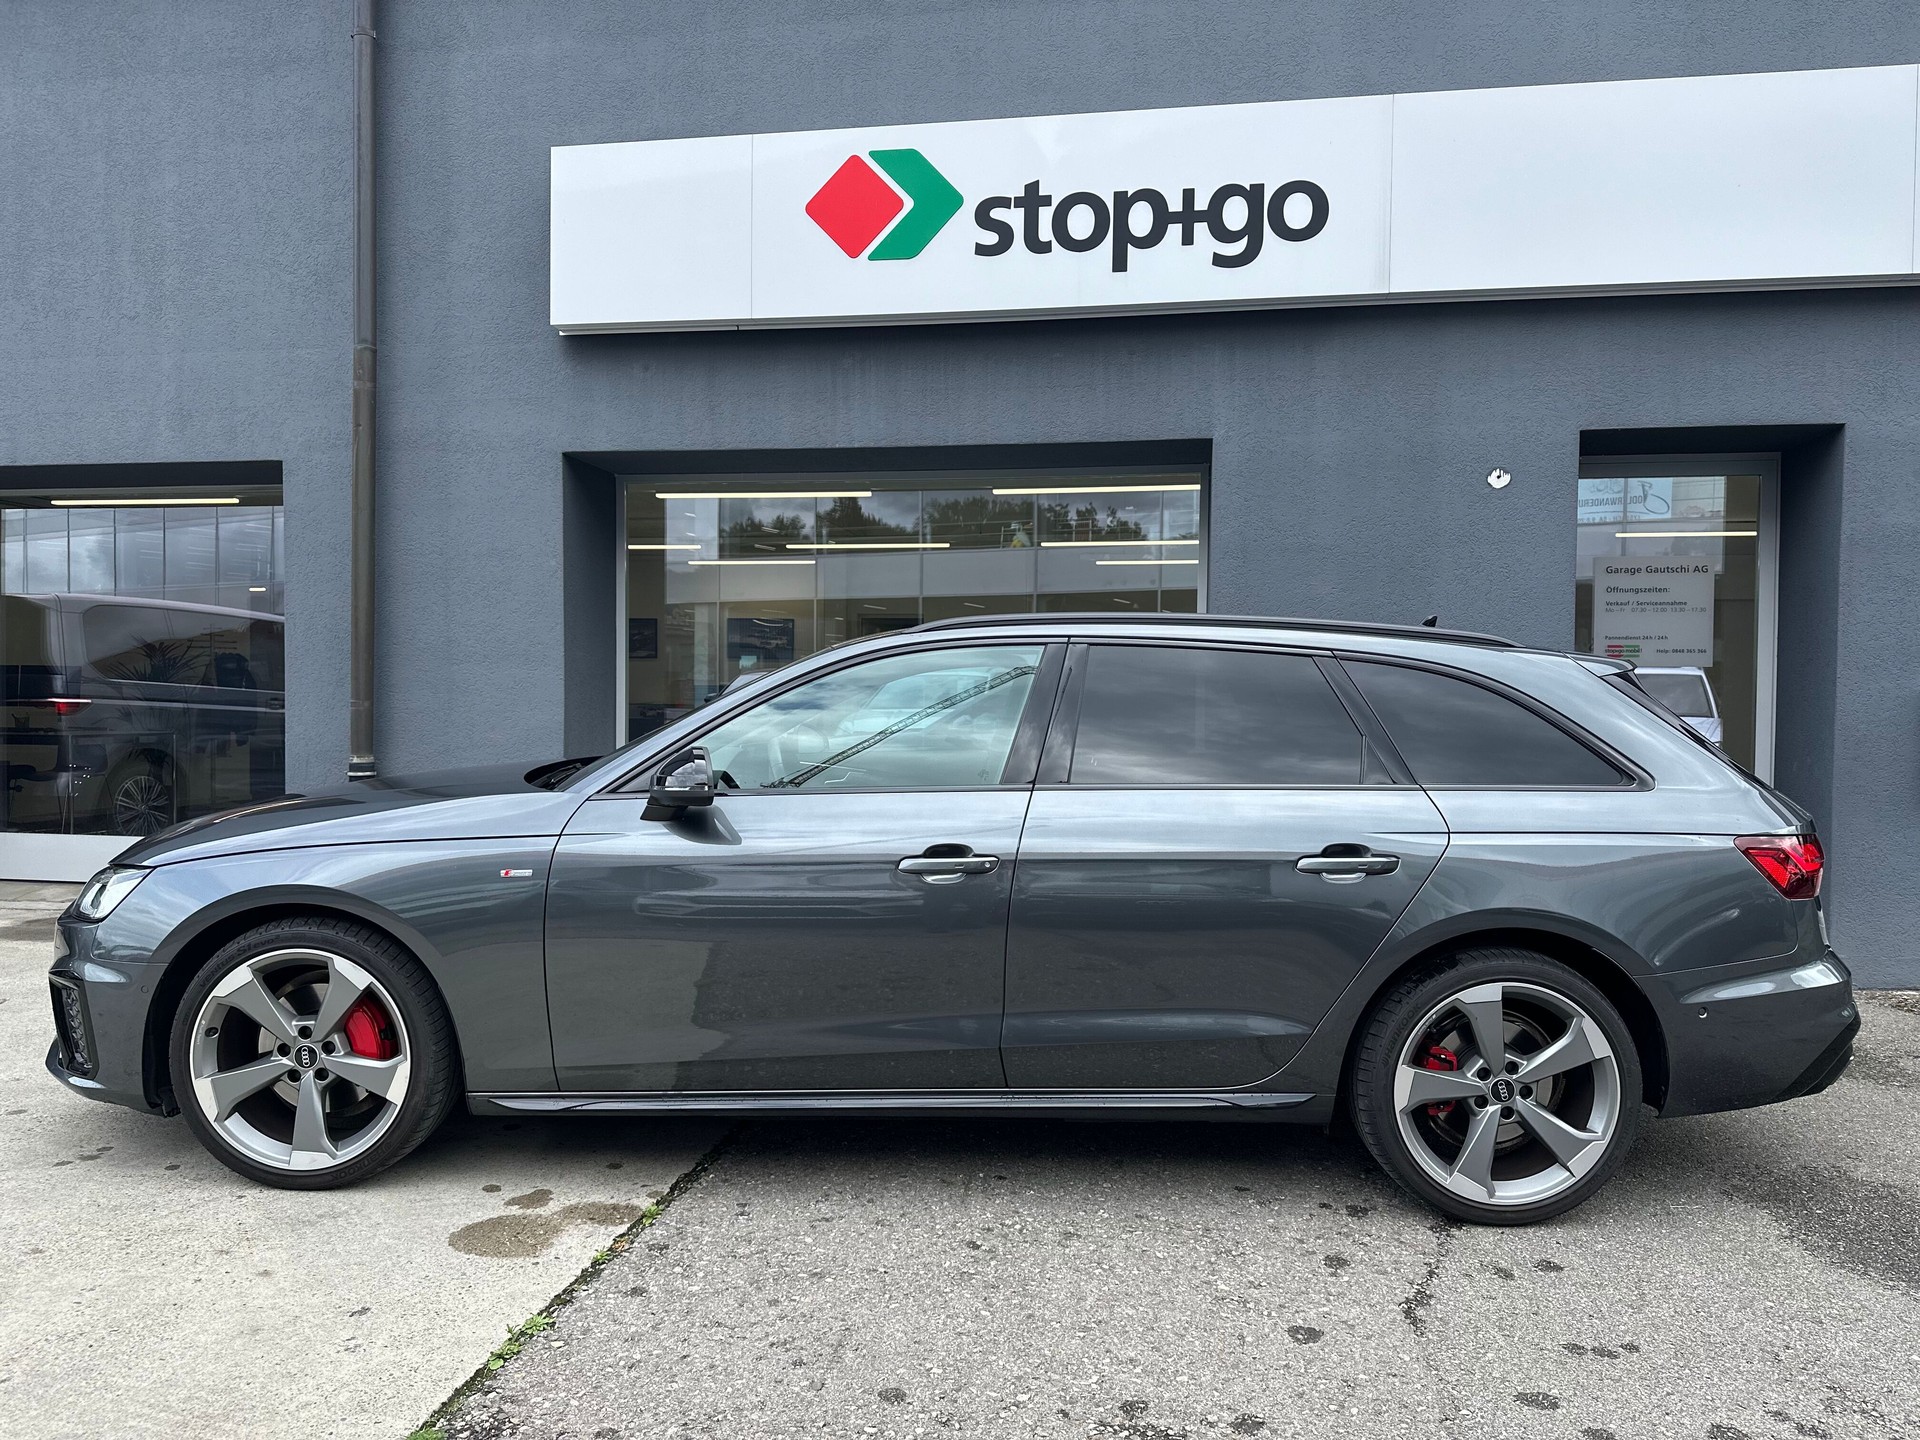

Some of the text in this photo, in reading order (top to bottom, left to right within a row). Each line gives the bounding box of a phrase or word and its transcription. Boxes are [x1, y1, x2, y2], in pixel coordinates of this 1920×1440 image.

[974, 179, 1330, 273] stop+go
[1605, 564, 1709, 576] Garage Gautschi AG
[1605, 585, 1671, 595] Öffnungszeiten:
